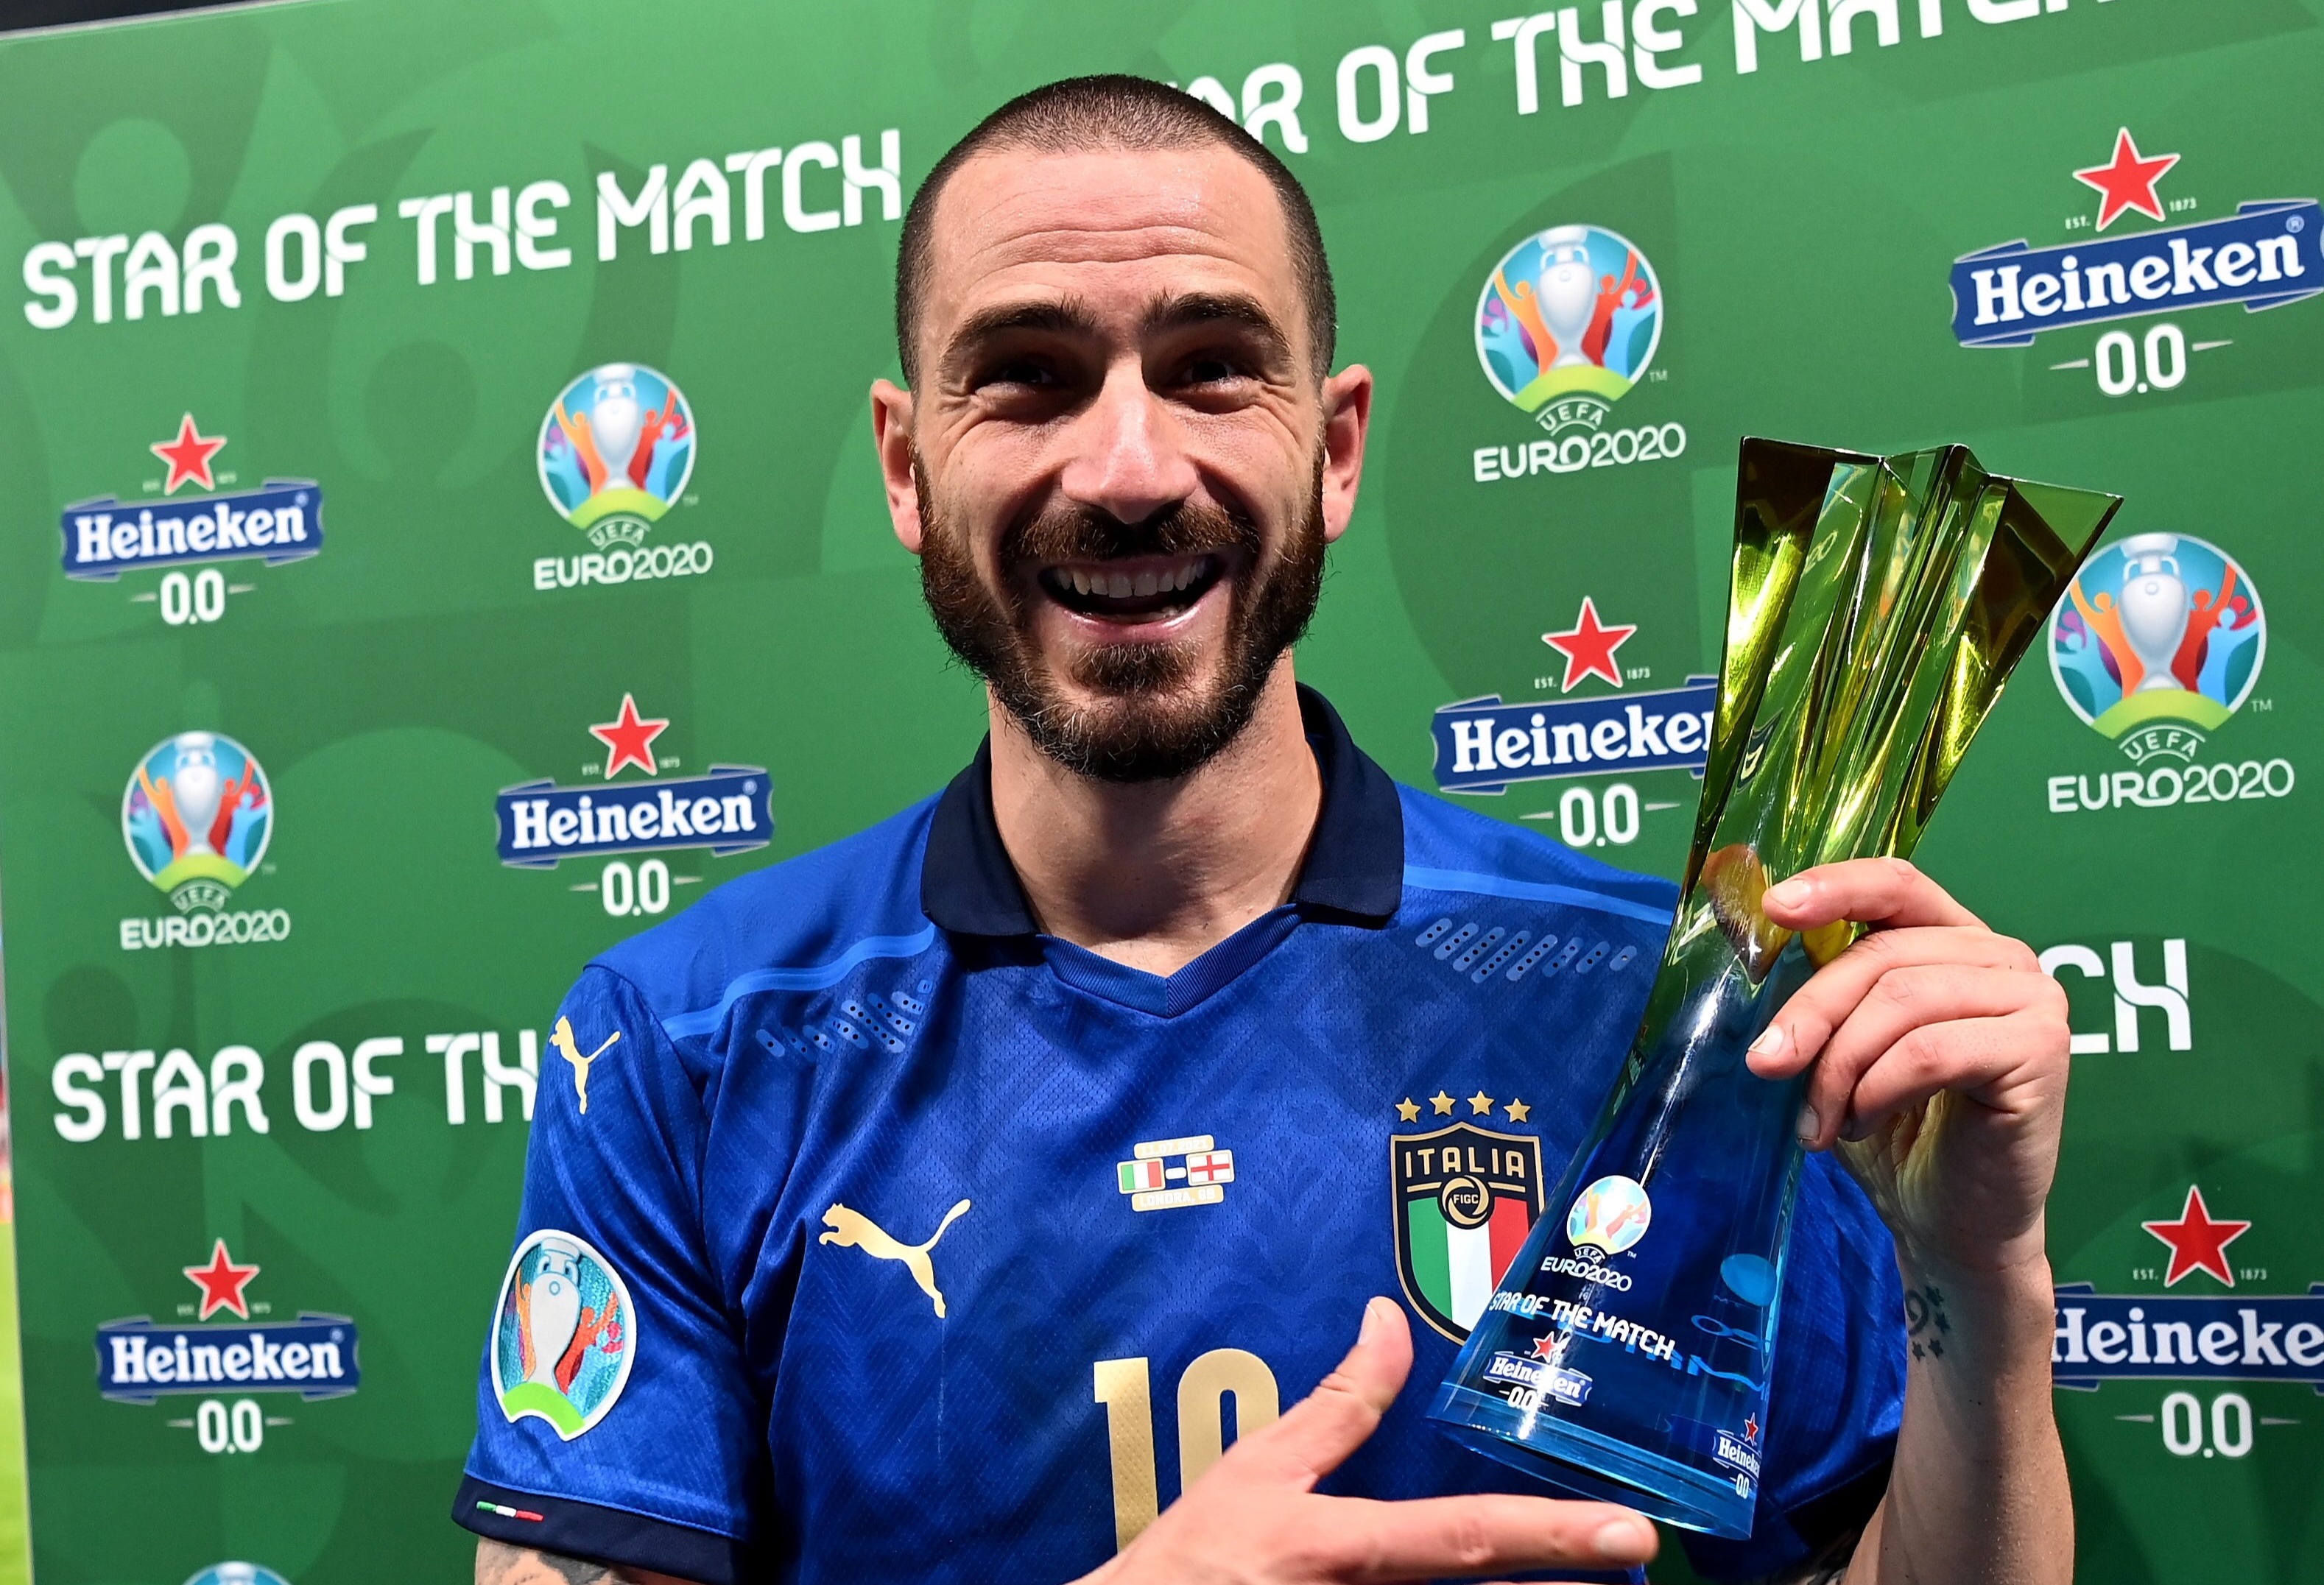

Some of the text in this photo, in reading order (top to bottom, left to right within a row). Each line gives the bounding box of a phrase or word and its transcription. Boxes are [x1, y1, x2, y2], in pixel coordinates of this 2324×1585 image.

[1335, 29, 1465, 143] OF
[1490, 0, 1702, 115] THE
[23, 128, 902, 329] STAR OF THE MATCH
[1971, 235, 2305, 325] Heineken
[2095, 322, 2186, 395] 0.0
[1540, 402, 1604, 431] UEFA
[75, 503, 307, 562] Heineken
[591, 520, 645, 547] UEFA
[161, 568, 225, 625] 0.0
[1534, 667, 1650, 689] EST. 1873
[2124, 731, 2198, 760] UEFA
[510, 789, 757, 849] Heineken
[1559, 783, 1640, 847] 0.0
[602, 859, 669, 917] 0.0
[52, 1029, 539, 1142] STAR OF TH
[1405, 1146, 1525, 1178] ITALIA
[1453, 1193, 1479, 1204] FIGC
[1574, 1248, 1602, 1263] UEFA
[2133, 1268, 2267, 1281] EST. 1873
[1488, 1291, 1676, 1360] STAR OF THE MATCH
[2051, 1307, 2324, 1366] Heineke
[110, 1333, 344, 1383] Heineken
[1489, 1356, 1582, 1398] Heineen
[197, 1399, 263, 1454] 0.0
[2161, 1391, 2253, 1458] 0.0
